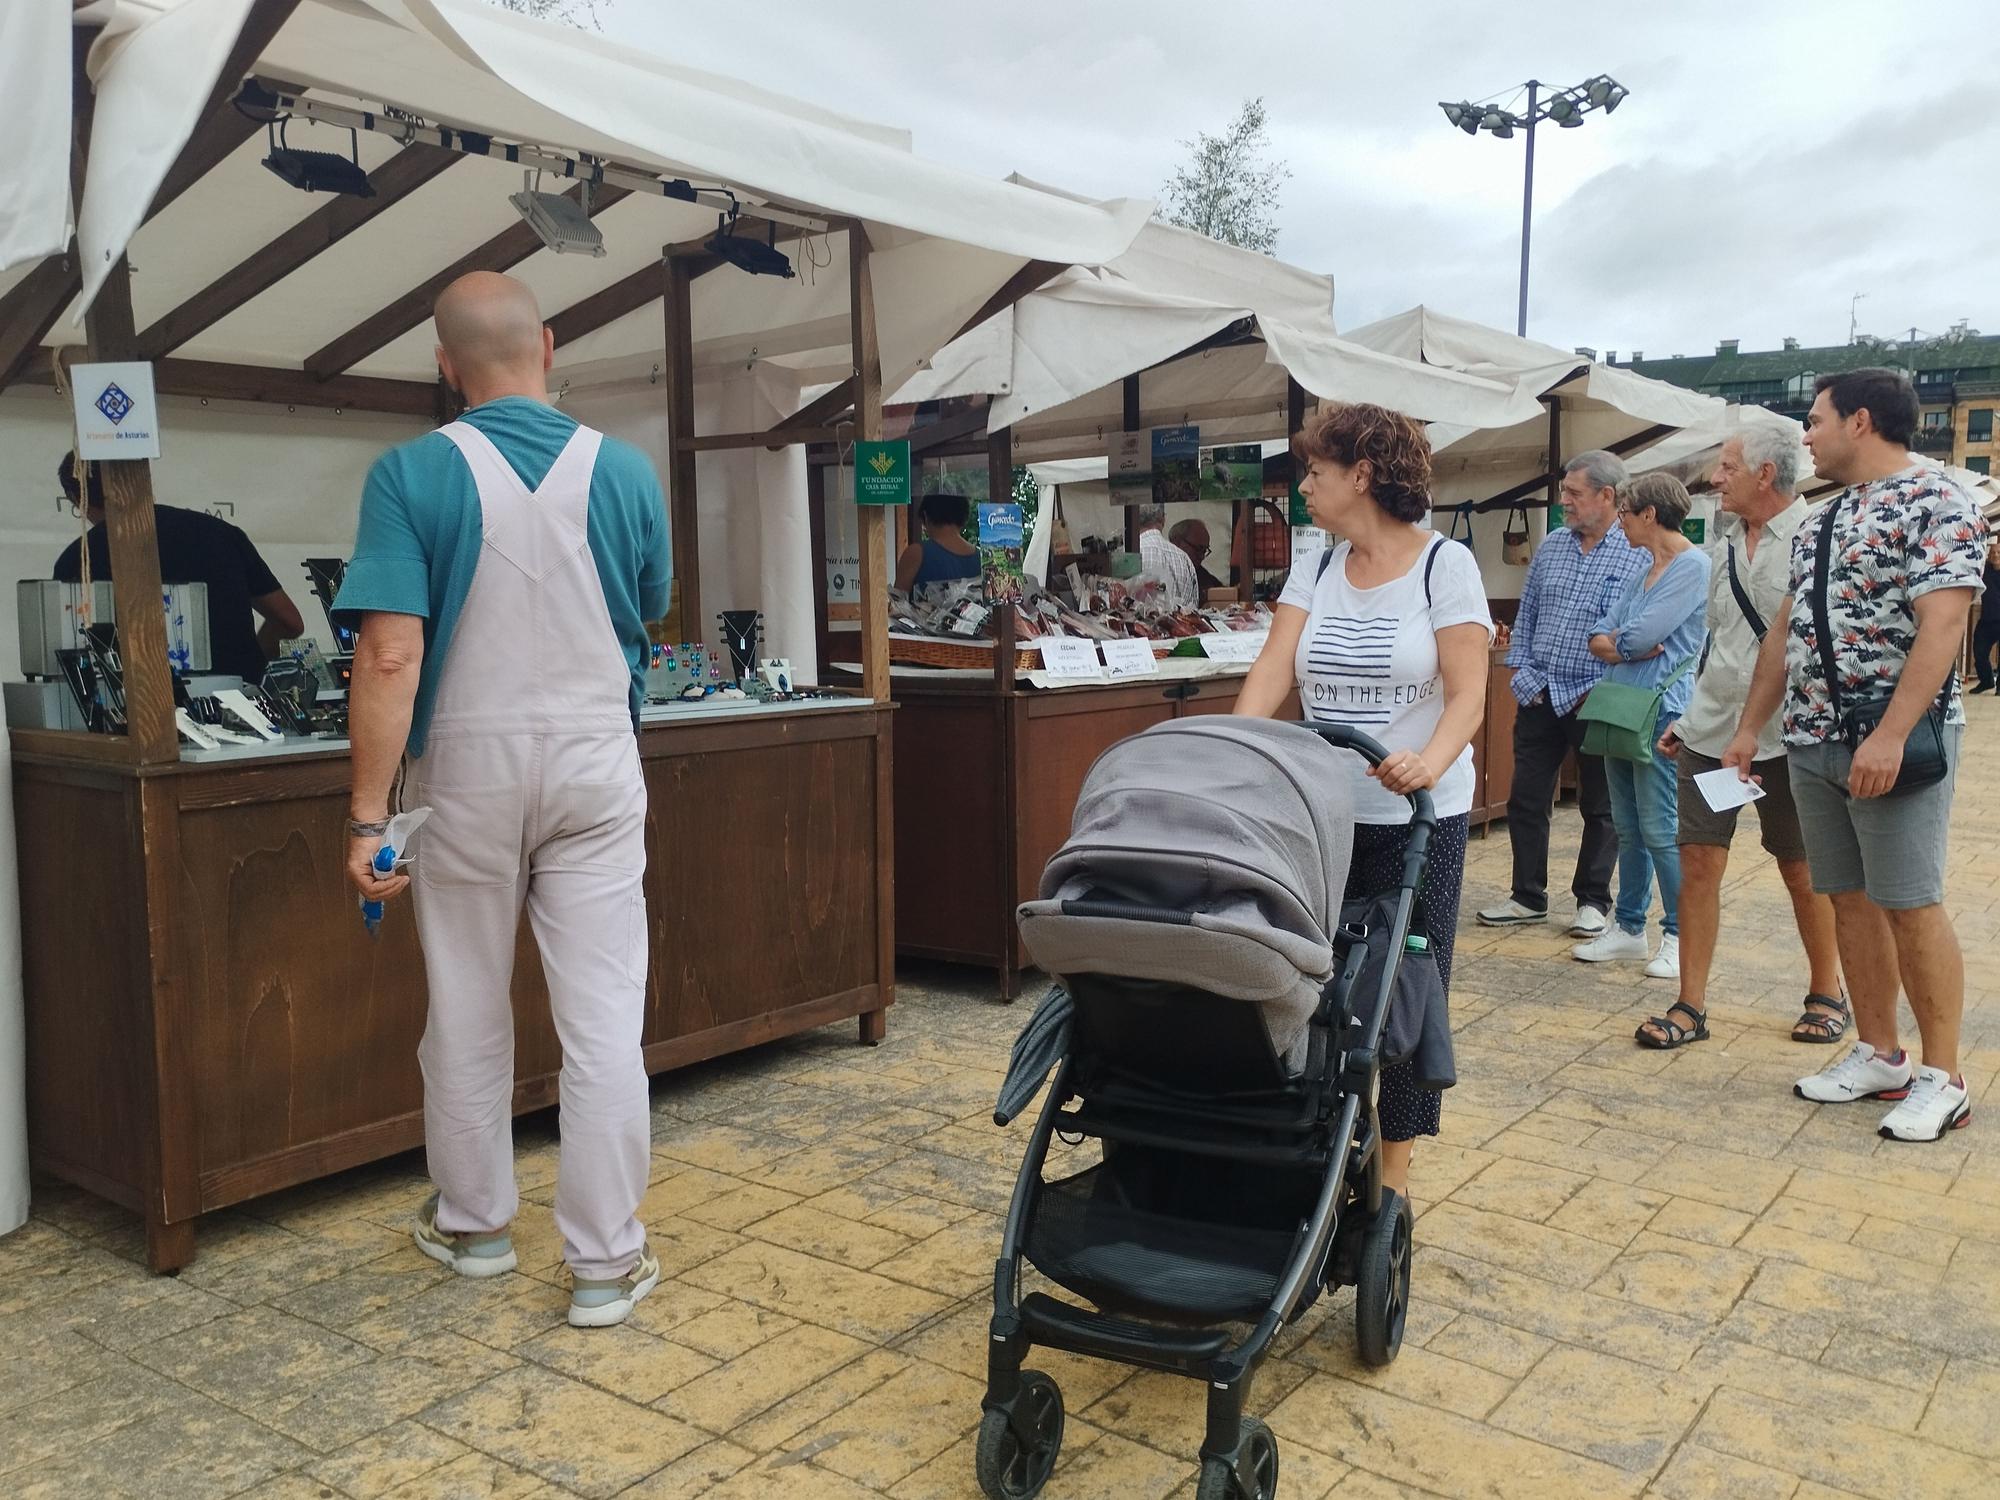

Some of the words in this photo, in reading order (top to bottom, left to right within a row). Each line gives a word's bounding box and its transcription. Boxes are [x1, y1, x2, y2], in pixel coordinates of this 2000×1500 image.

[115, 431, 123, 440] de
[1314, 682, 1338, 702] ON
[1346, 685, 1383, 703] THE
[1394, 676, 1438, 704] EDGE
